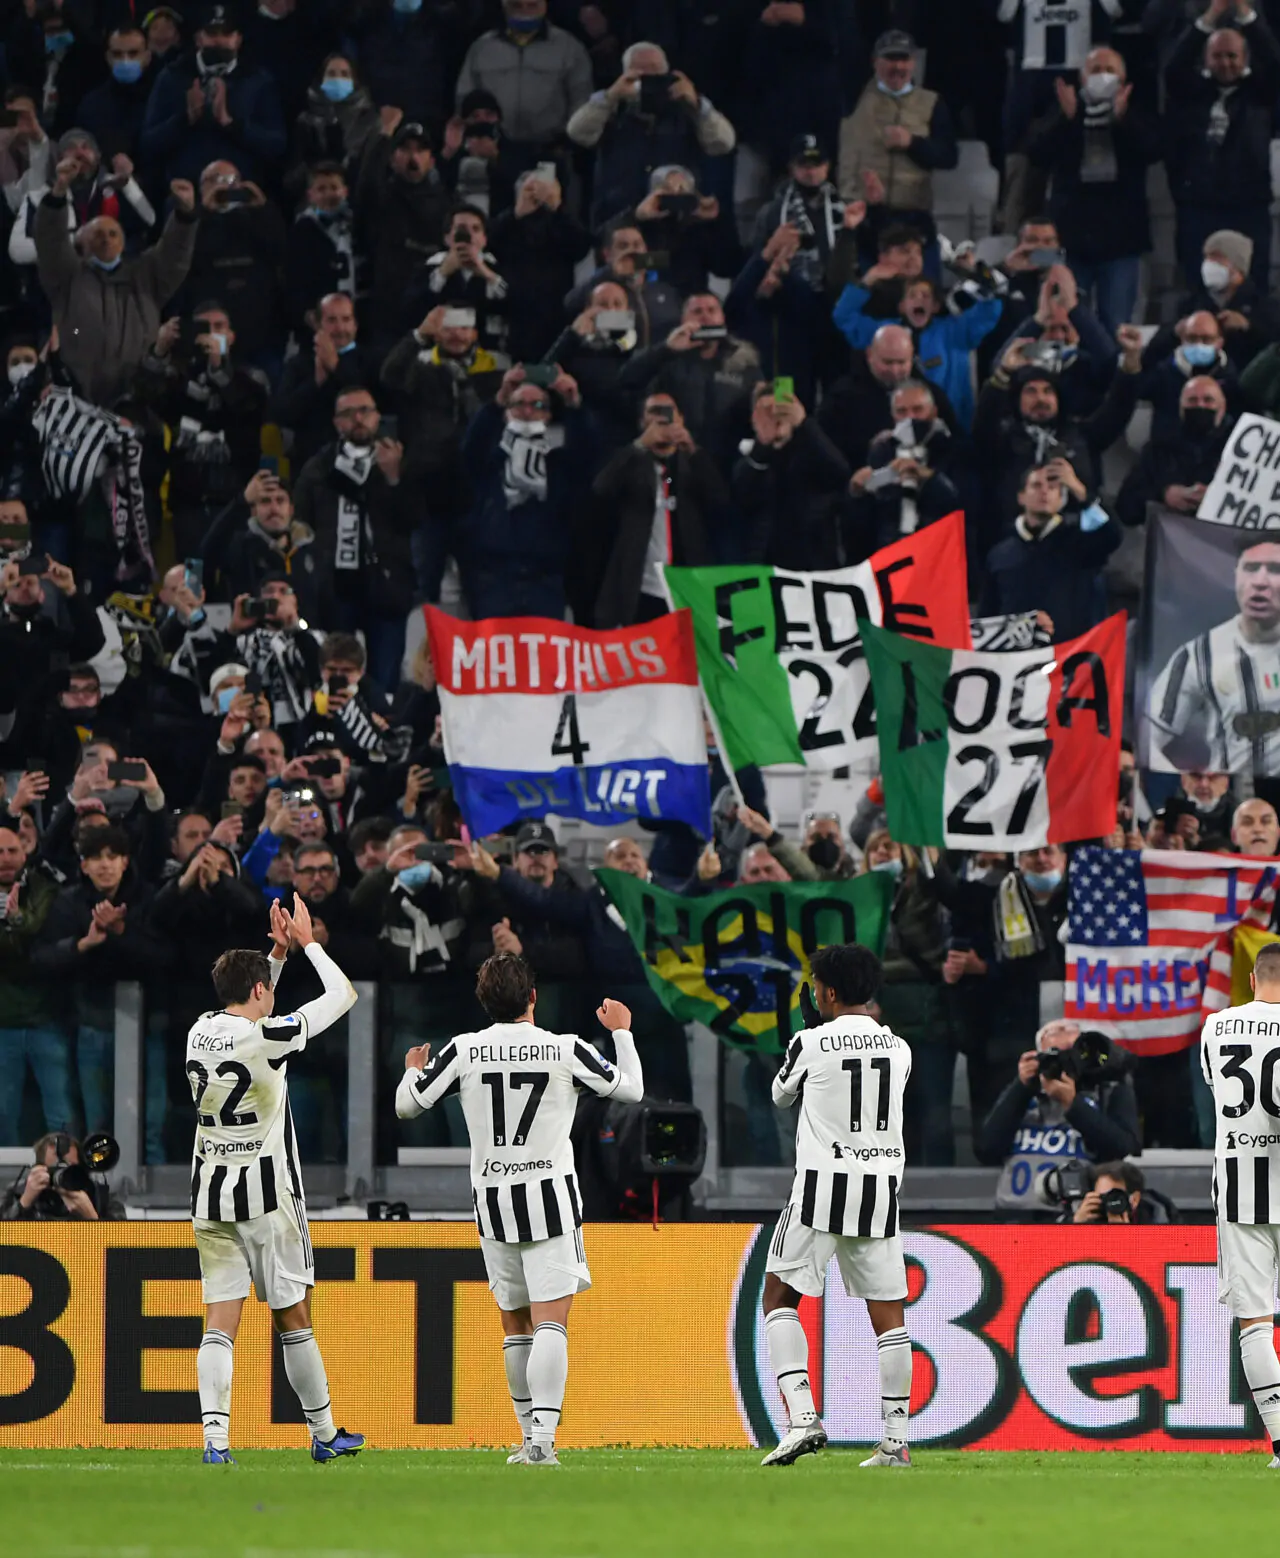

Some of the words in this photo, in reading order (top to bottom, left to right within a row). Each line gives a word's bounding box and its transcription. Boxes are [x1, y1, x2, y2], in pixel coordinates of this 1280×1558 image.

[1226, 462, 1258, 494] MI
[715, 556, 934, 655] FEDE
[551, 694, 590, 765] 4
[898, 652, 1110, 752] LOCA
[505, 777, 570, 809] DE
[578, 768, 667, 817] LIGT
[947, 743, 1054, 836] 27
[470, 1045, 561, 1063] PELLEGRINI
[186, 1059, 259, 1127] 22
[482, 1072, 550, 1146] 17
[842, 1057, 891, 1132] 11
[204, 1139, 263, 1156] Cygames
[490, 1159, 553, 1175] Cygames
